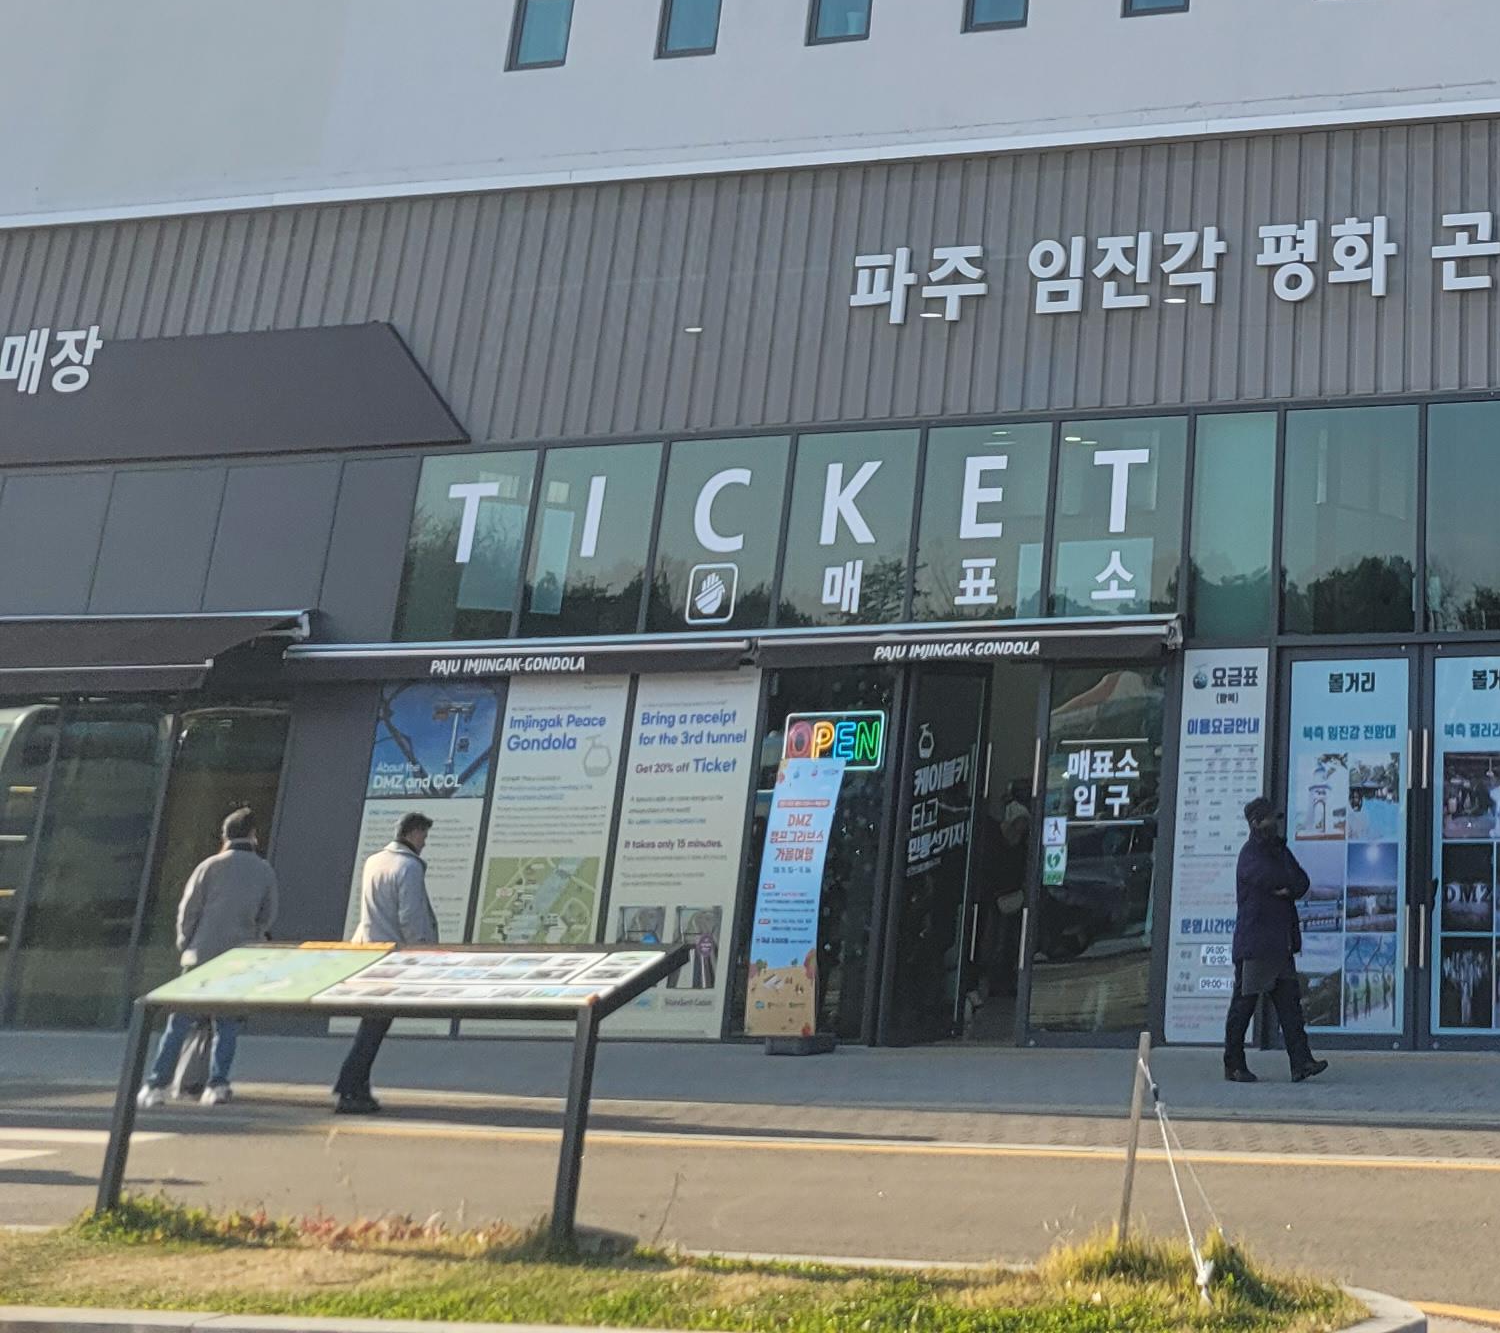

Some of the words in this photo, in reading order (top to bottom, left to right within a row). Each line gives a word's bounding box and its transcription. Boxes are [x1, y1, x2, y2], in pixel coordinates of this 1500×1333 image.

[849, 244, 989, 325] 파주
[1028, 226, 1228, 314] 임진각
[1256, 215, 1399, 303] 평화
[0, 325, 103, 394] 매장
[448, 448, 1150, 564] TICKET
[874, 644, 907, 661] PAJU
[908, 640, 1040, 660] IMJINGAK-GONDOLA
[430, 659, 459, 675] PAJU
[463, 656, 585, 675] IMJINGAK-GONDOLA
[1211, 667, 1258, 688] 요금표
[1328, 672, 1376, 693] 볼거리
[509, 714, 562, 732] Imjingak
[566, 712, 606, 728] Peace
[641, 711, 676, 729] Bring
[678, 714, 688, 726] a
[690, 708, 737, 727] receipt
[1187, 718, 1260, 735] 이용요금안내
[507, 734, 577, 751] Gondola
[638, 732, 656, 746] for
[658, 732, 678, 746] the
[681, 731, 703, 745] 3rd
[706, 729, 748, 745] tunnel
[786, 719, 882, 761] OPEN
[635, 763, 652, 774] Get
[675, 761, 690, 774] off
[692, 758, 737, 774] Ticket
[914, 754, 970, 797] 케이블카
[1068, 749, 1140, 781] 매표소
[373, 775, 404, 789] DMZ
[407, 773, 431, 789] and
[1074, 785, 1130, 817] 입구
[787, 813, 813, 827] DMZ
[911, 797, 939, 832] 타고
